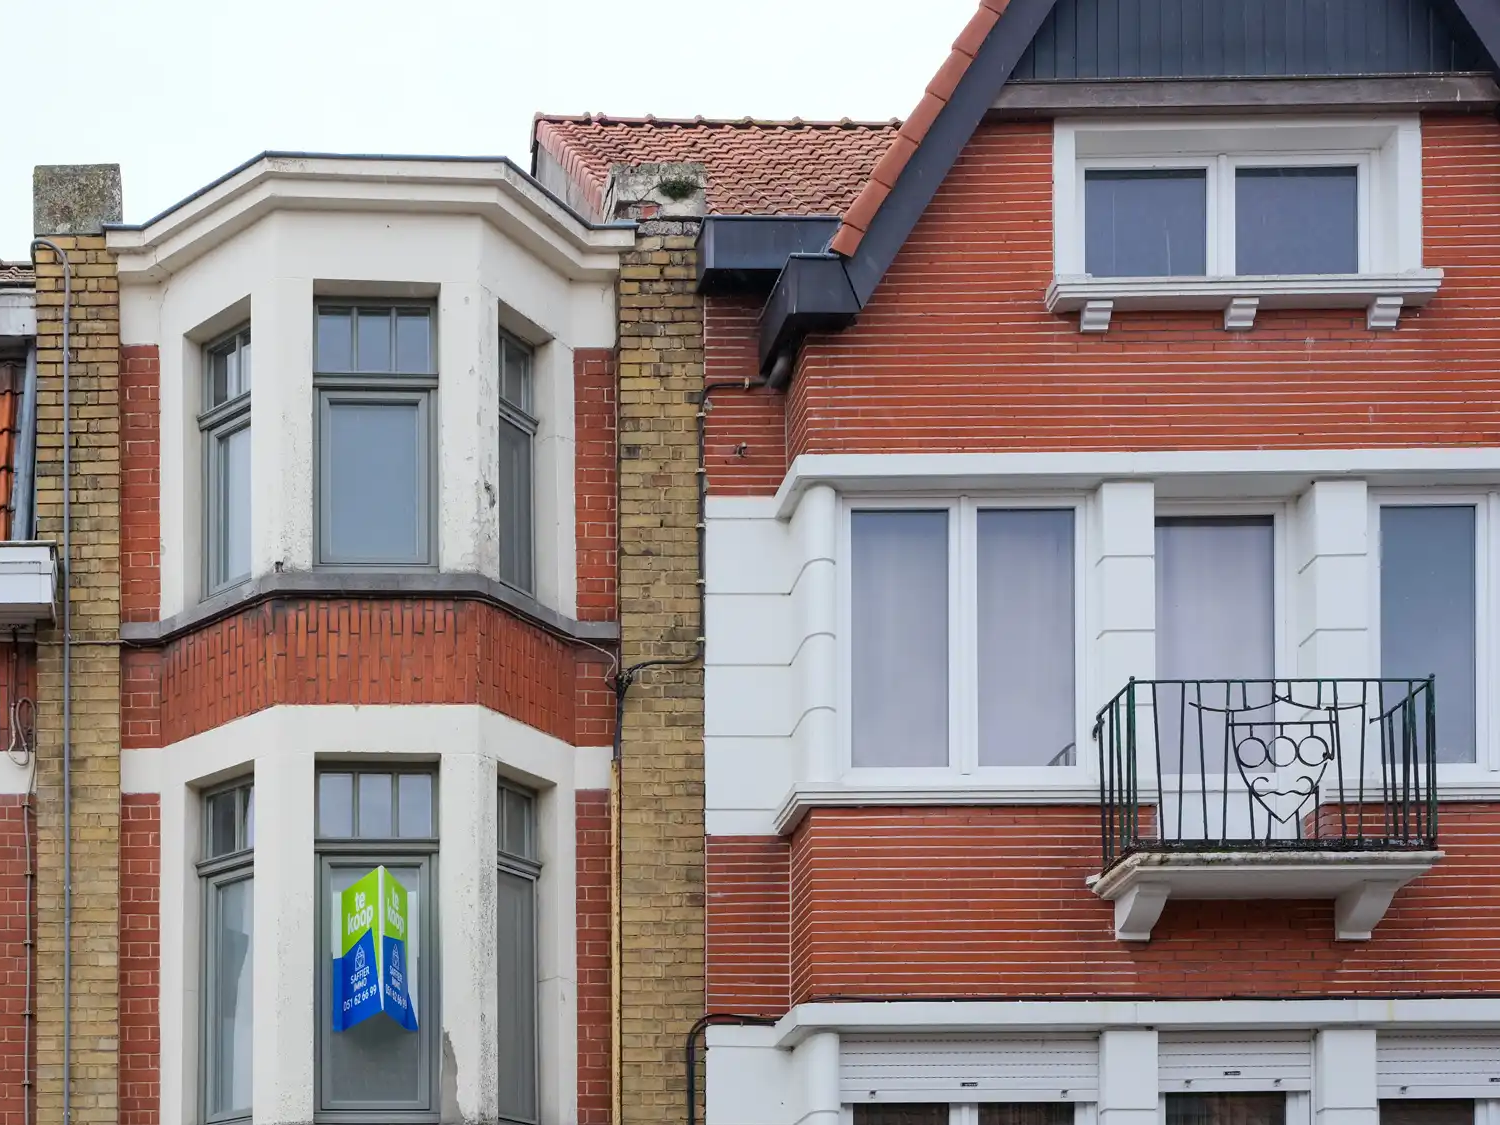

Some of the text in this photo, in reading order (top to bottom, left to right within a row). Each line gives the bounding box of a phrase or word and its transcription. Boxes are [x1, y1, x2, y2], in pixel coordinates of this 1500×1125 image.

[355, 892, 366, 912] te
[348, 905, 373, 935] koop
[350, 966, 370, 984] SAFFIER
[370, 984, 377, 996] 99
